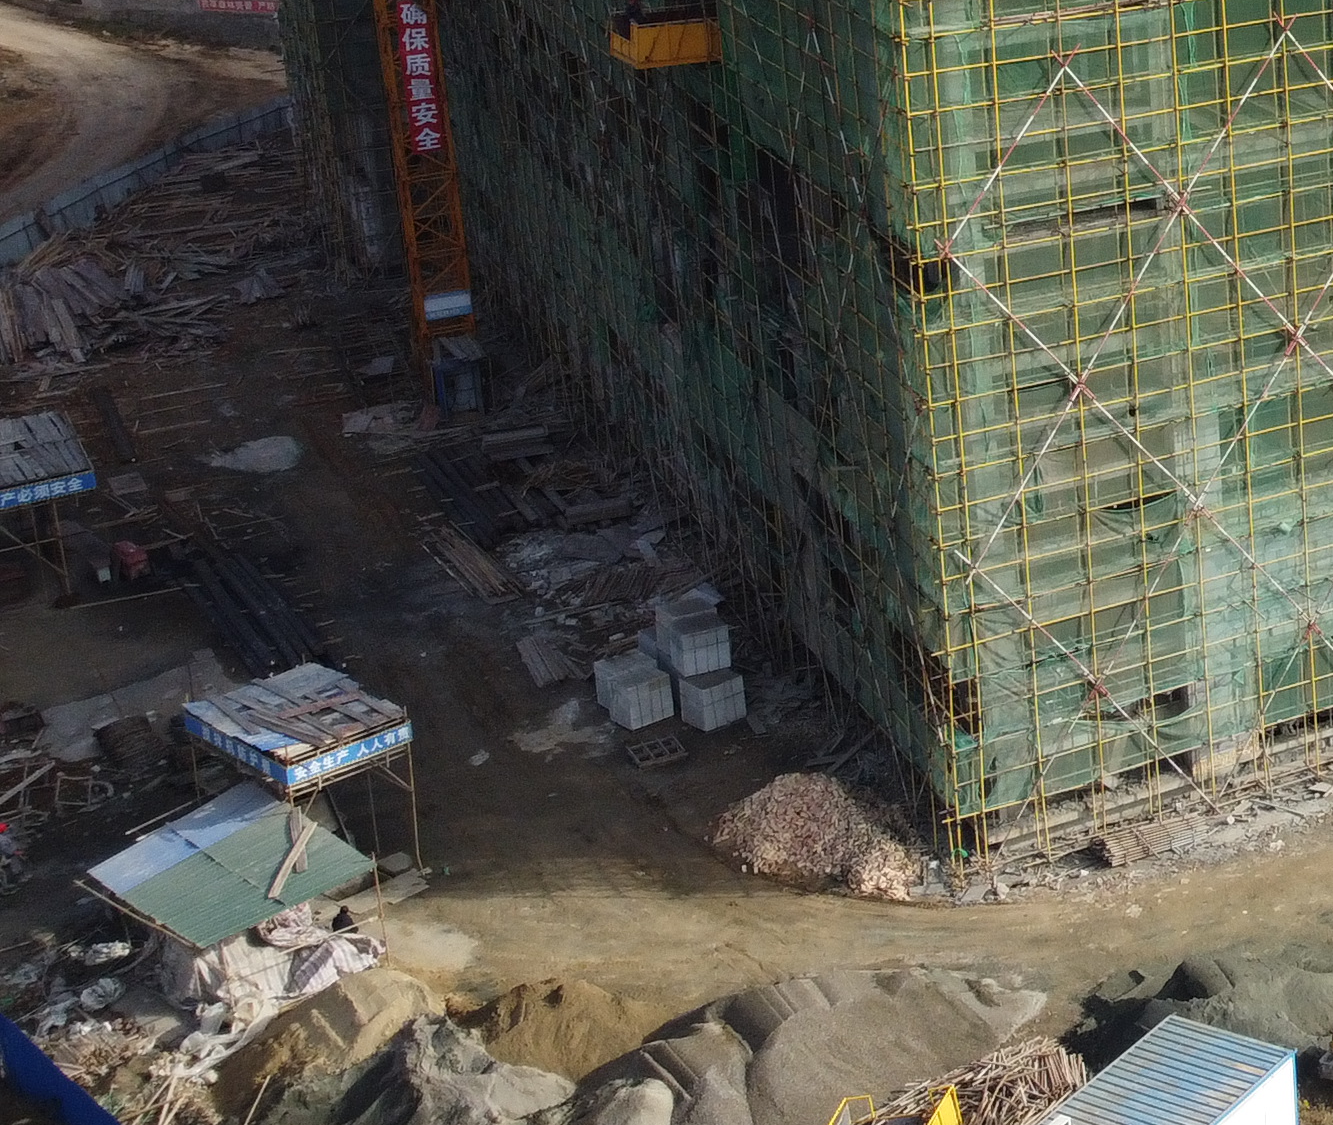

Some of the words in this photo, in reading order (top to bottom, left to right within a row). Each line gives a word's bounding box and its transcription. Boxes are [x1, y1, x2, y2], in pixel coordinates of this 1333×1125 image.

[400, 3, 441, 151] 确保质量安全
[293, 750, 350, 778] 安全生产
